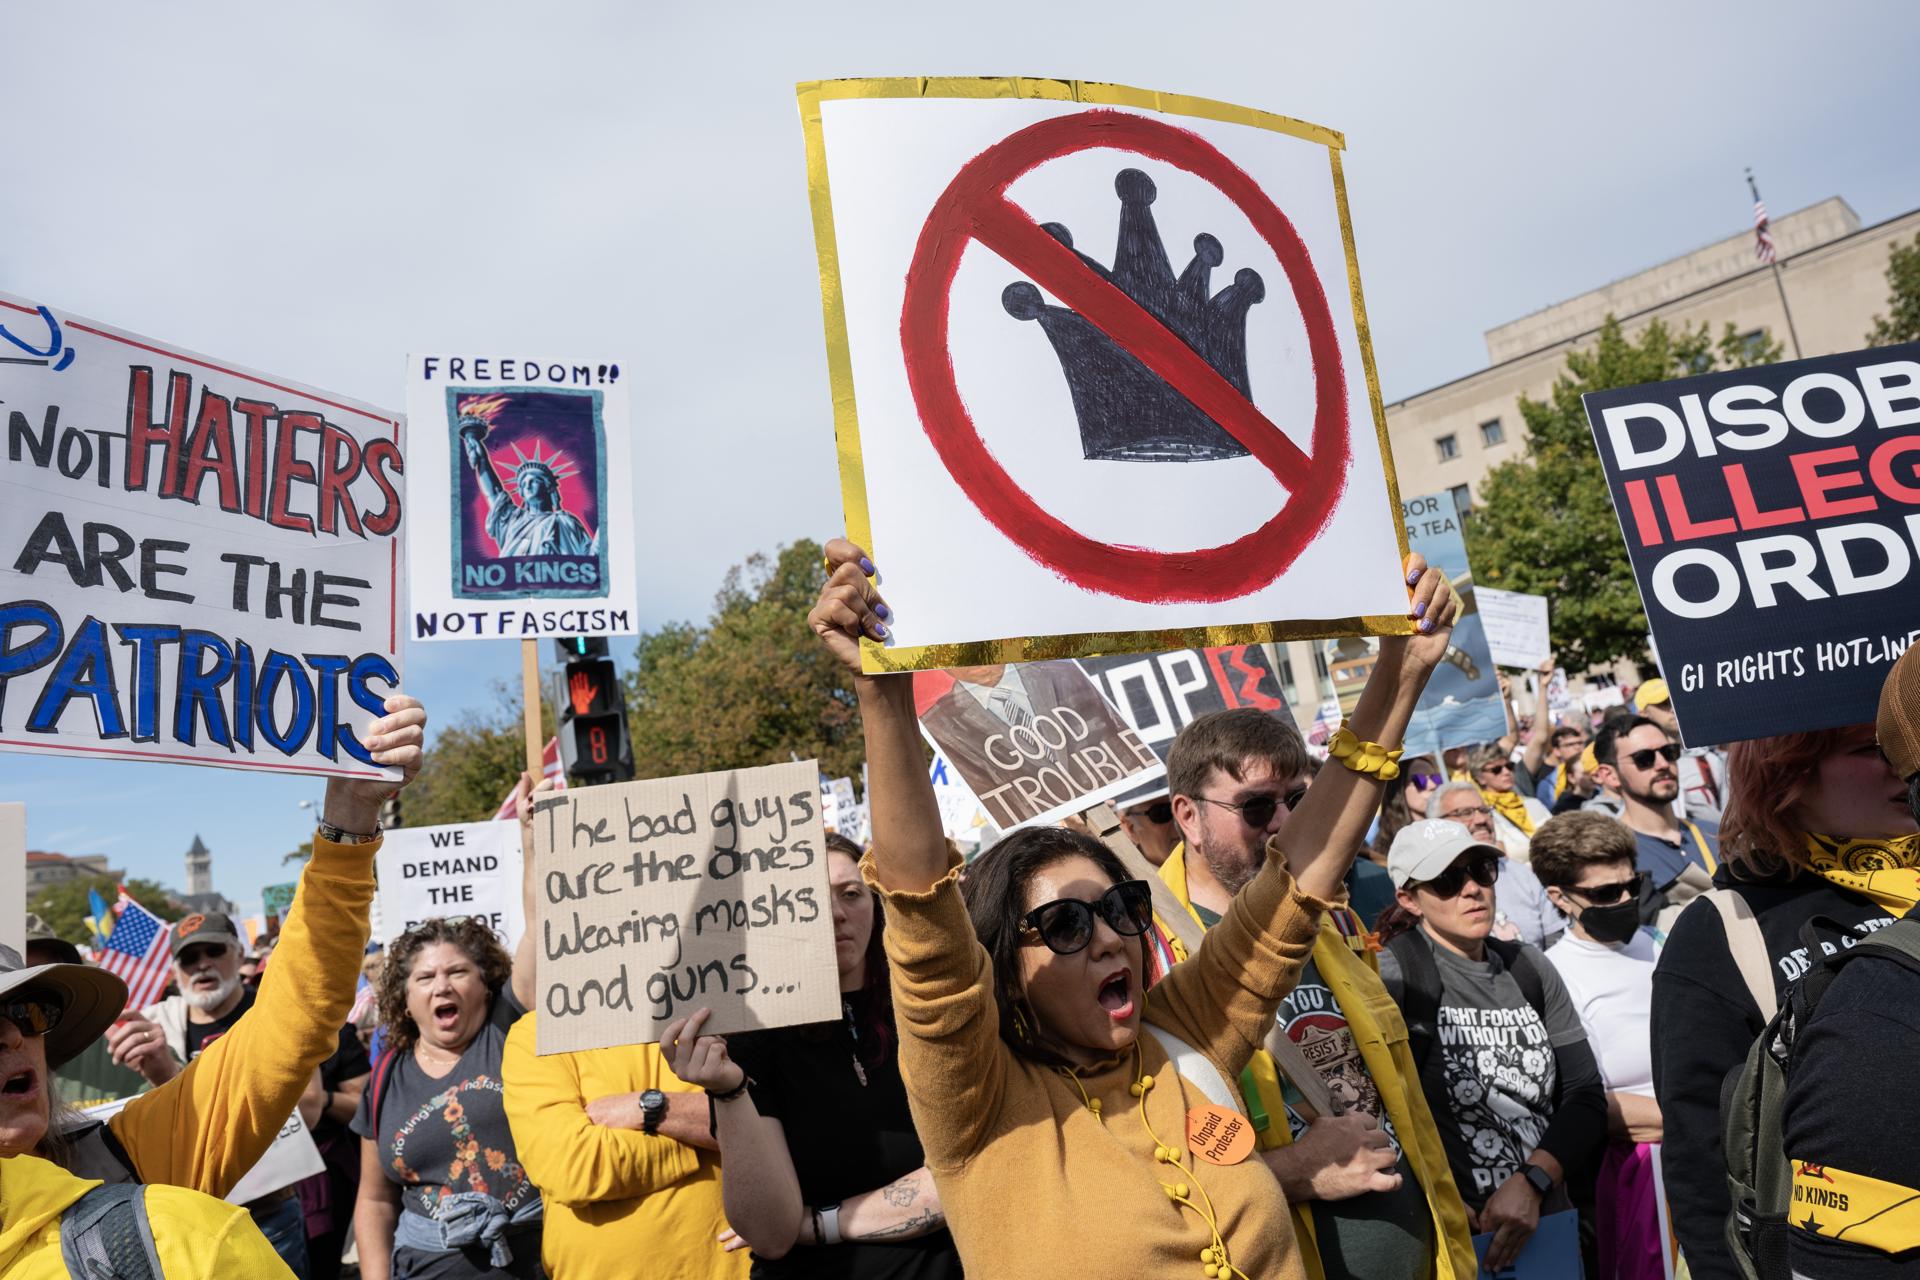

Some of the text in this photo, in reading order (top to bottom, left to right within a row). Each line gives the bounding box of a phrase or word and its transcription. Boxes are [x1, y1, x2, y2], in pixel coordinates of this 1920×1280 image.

[424, 357, 619, 386] FREEDOM!!
[1601, 360, 1920, 471] DISOB
[8, 364, 404, 539] NOT HATERS
[1402, 498, 1439, 518] BOR
[1624, 435, 1920, 547] ILLEG
[1421, 518, 1456, 536] TEA
[13, 511, 372, 631] ARE THE
[465, 561, 598, 586] NO KINGS
[1652, 514, 1920, 619] ORD
[416, 609, 631, 638] NOT FASCISM
[0, 599, 399, 767] PATRIOTS
[1681, 663, 1704, 692] GI
[1716, 646, 1804, 688] RIGHTS
[1090, 649, 1208, 744] OP
[984, 706, 1089, 770] GOOD
[979, 728, 1159, 825] TROUBLE
[430, 830, 465, 848] WE
[533, 790, 814, 853] The bad guys
[402, 855, 498, 878] DEMAND
[545, 840, 814, 904] are the ones
[428, 885, 474, 904] THE
[696, 884, 820, 935] masks
[546, 963, 633, 1017] and
[1283, 989, 1324, 1014] YOU
[1437, 1006, 1477, 1026] FIGHT
[1437, 1025, 1519, 1046] WITHOUT
[1302, 1039, 1339, 1061] RESIST
[395, 1105, 434, 1156] no kings
[1190, 1111, 1223, 1146] Unpaid
[1205, 1117, 1243, 1162] Protester
[1806, 1186, 1849, 1212] KINGS
